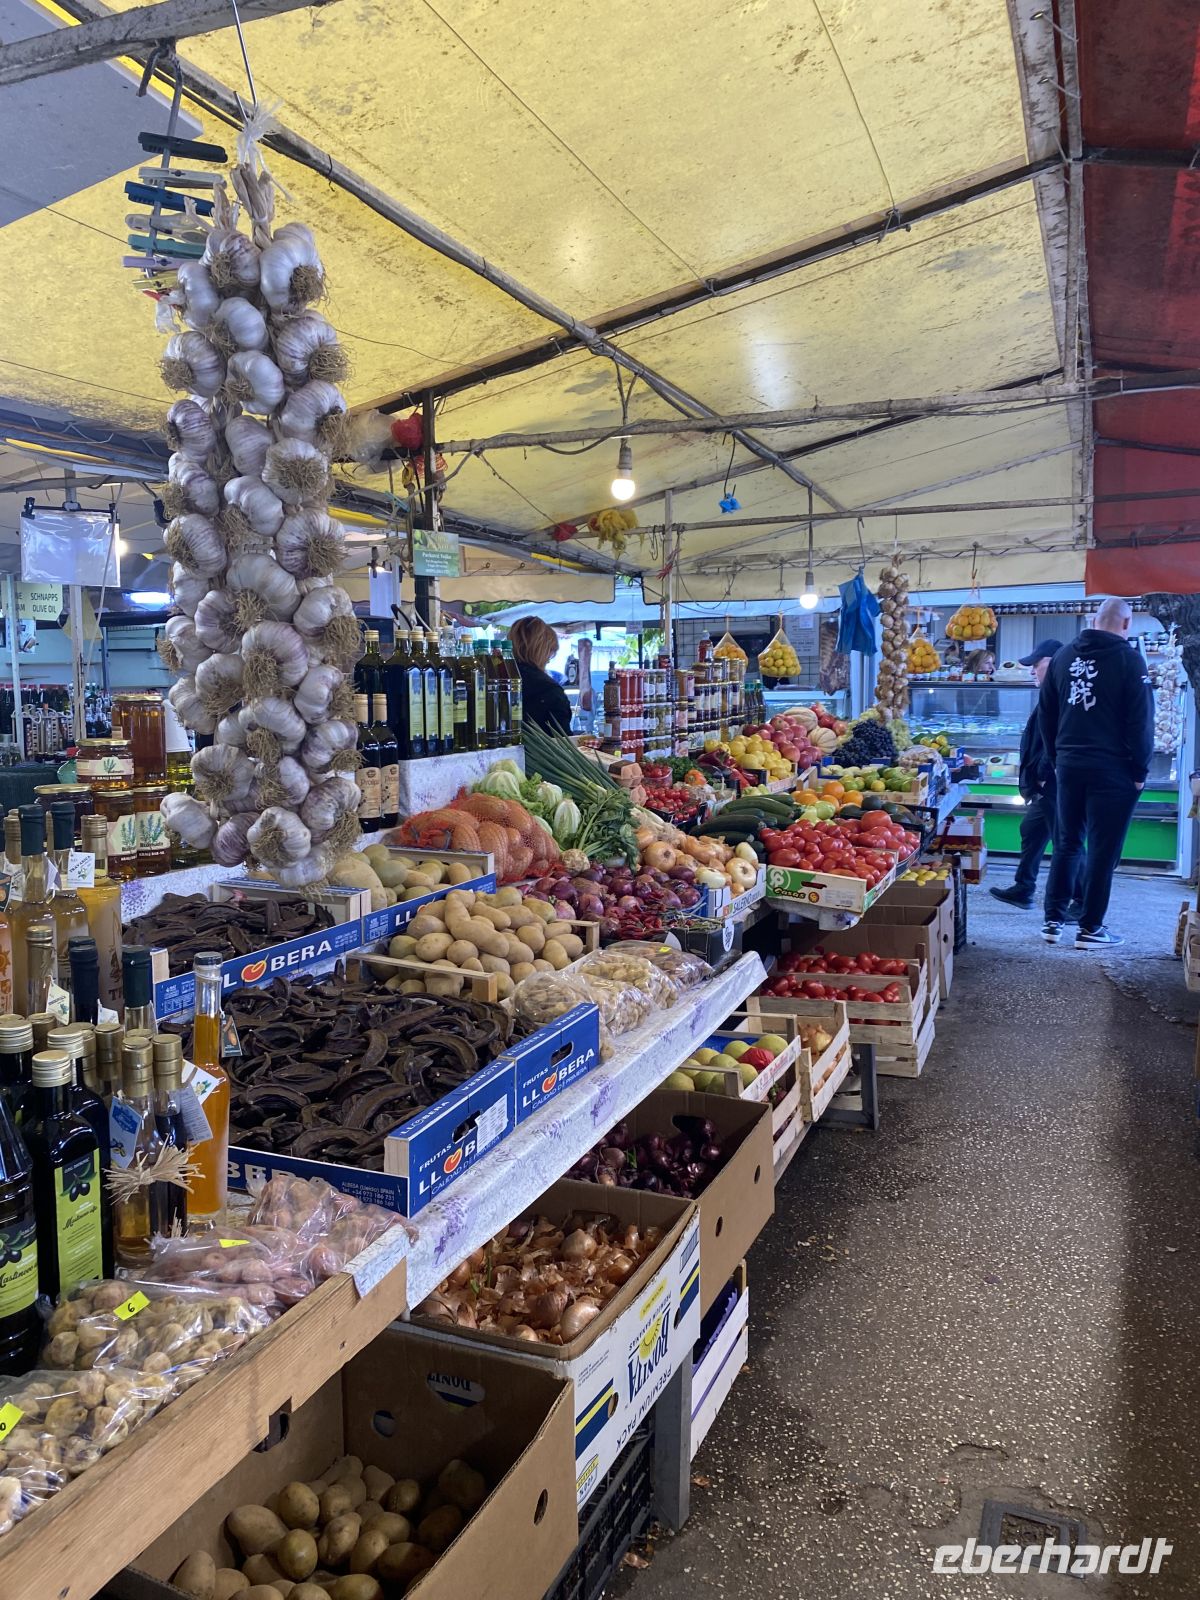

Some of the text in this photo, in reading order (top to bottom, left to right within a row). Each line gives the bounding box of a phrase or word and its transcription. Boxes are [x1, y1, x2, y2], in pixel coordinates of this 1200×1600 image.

[30, 592, 59, 602] SCHNAPPS
[32, 604, 57, 614] OLIVE OIL
[270, 939, 333, 973] BERA
[522, 1067, 550, 1090] FRUTAS
[558, 1047, 596, 1082] BERA
[532, 1088, 558, 1110] CALIDAD
[419, 1143, 453, 1173] FRUTAS
[431, 1164, 464, 1196] CALIDAD
[127, 1302, 136, 1313] 6
[627, 1308, 671, 1405] BONITA
[615, 1363, 672, 1454] PREMIUM PACK
